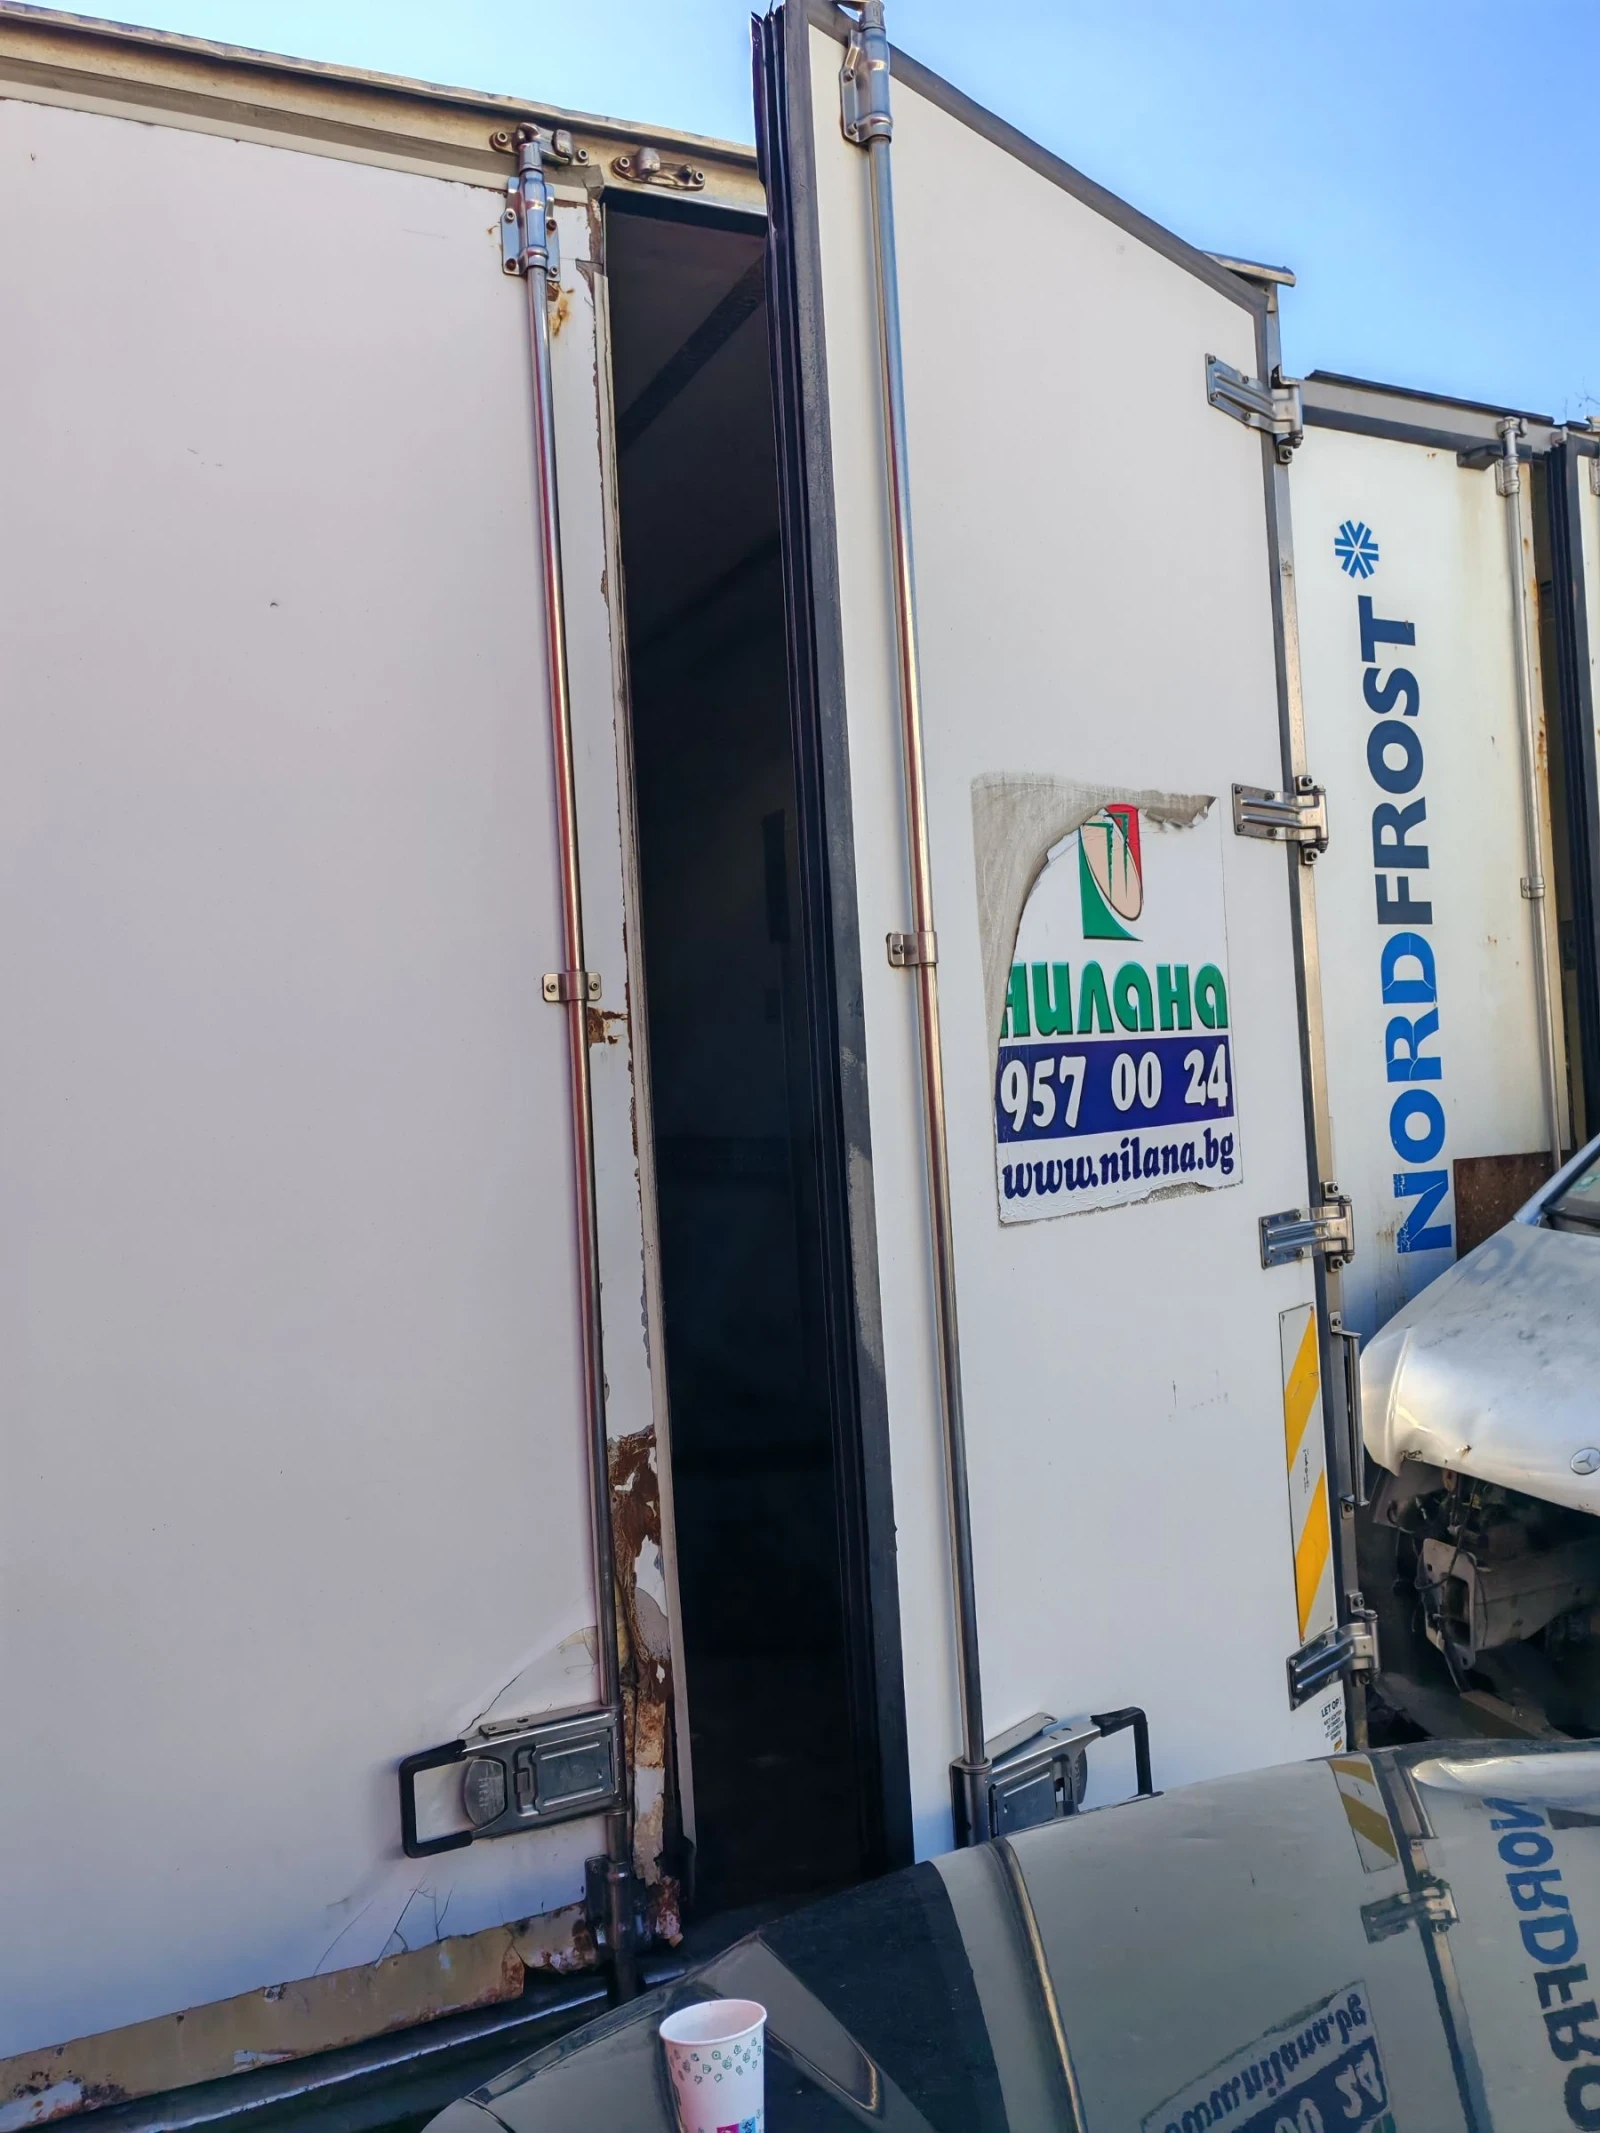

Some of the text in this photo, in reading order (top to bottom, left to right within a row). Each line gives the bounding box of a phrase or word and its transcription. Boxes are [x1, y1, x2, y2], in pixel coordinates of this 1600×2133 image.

[1358, 595, 1454, 1255] NORDFROST
[1000, 1043, 1229, 1132] 957 00 24
[1002, 1127, 1235, 1200] www.nilana.bg
